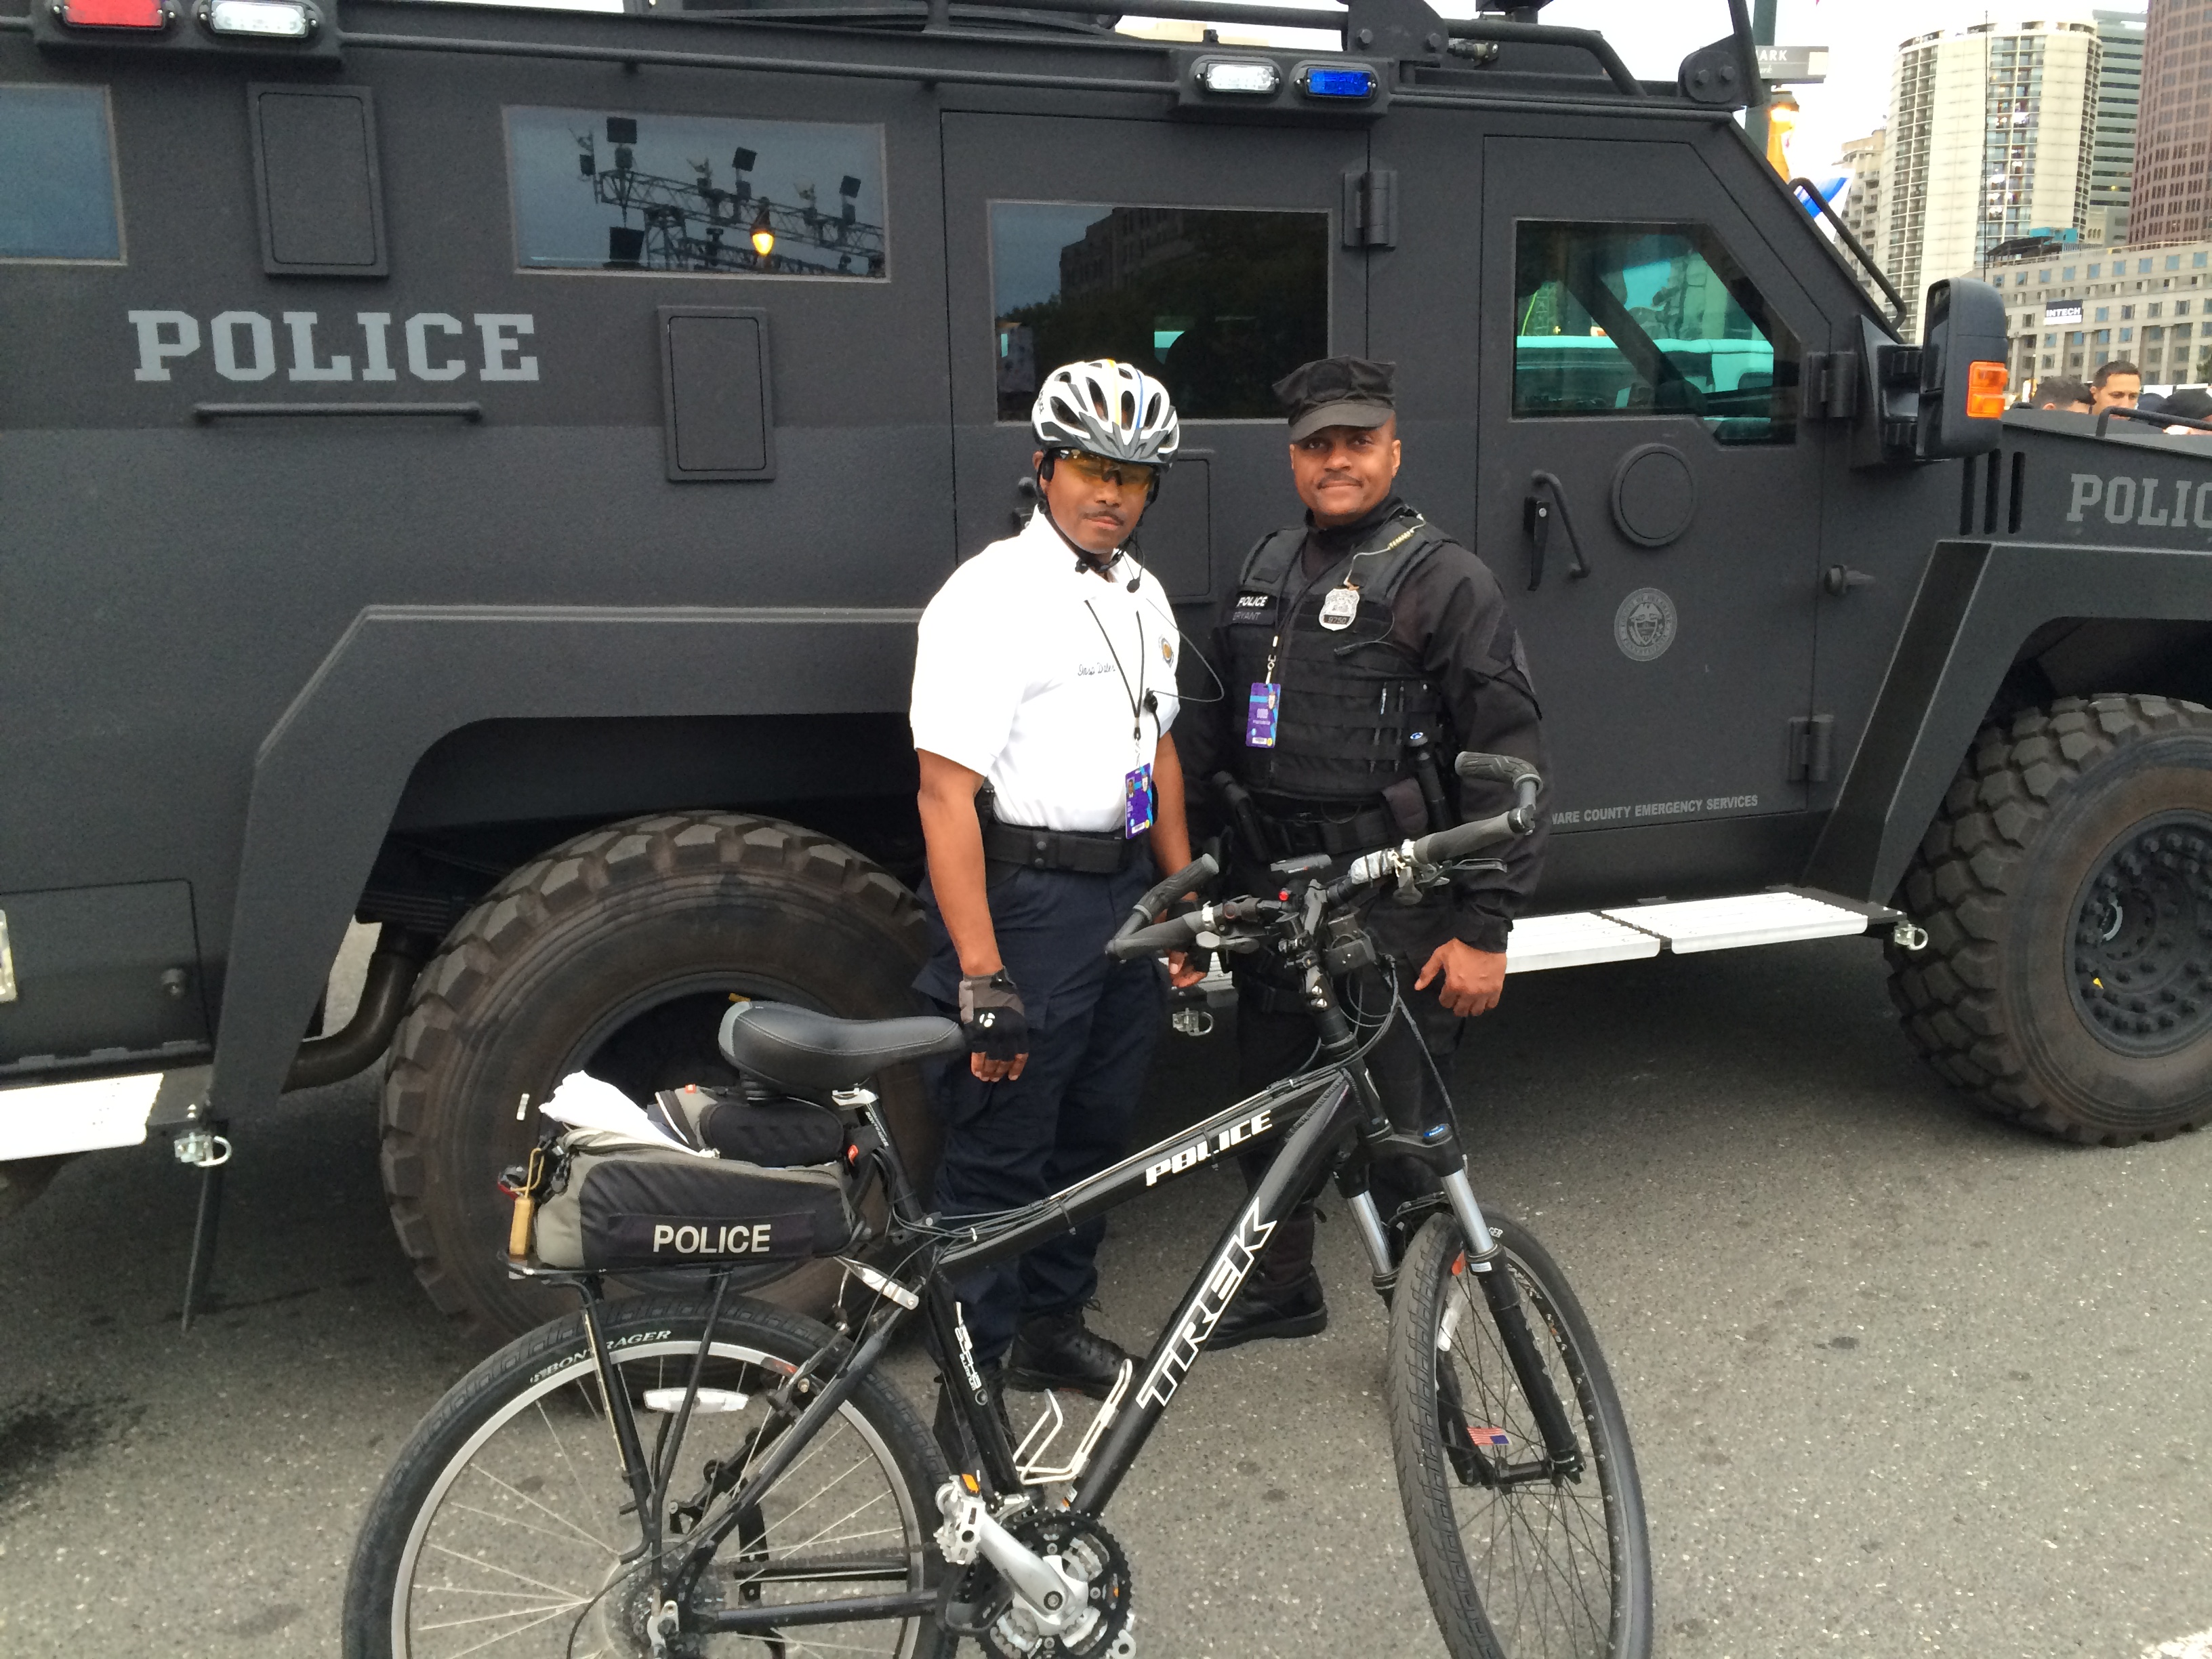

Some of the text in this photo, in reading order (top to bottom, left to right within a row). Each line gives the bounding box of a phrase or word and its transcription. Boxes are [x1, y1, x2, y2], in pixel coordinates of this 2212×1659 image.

[1756, 49, 1787, 61] ARK
[2046, 307, 2081, 317] INTECH
[128, 310, 539, 381] POLICE
[1235, 596, 1268, 607] POLICE
[1584, 806, 1631, 821] COUNTY
[1635, 799, 1703, 817] EMERGENCY
[1706, 794, 1759, 811] SERVICES
[1145, 1109, 1273, 1187] POLICE
[653, 1224, 771, 1254] POLICE
[1136, 1196, 1277, 1410] TREK
